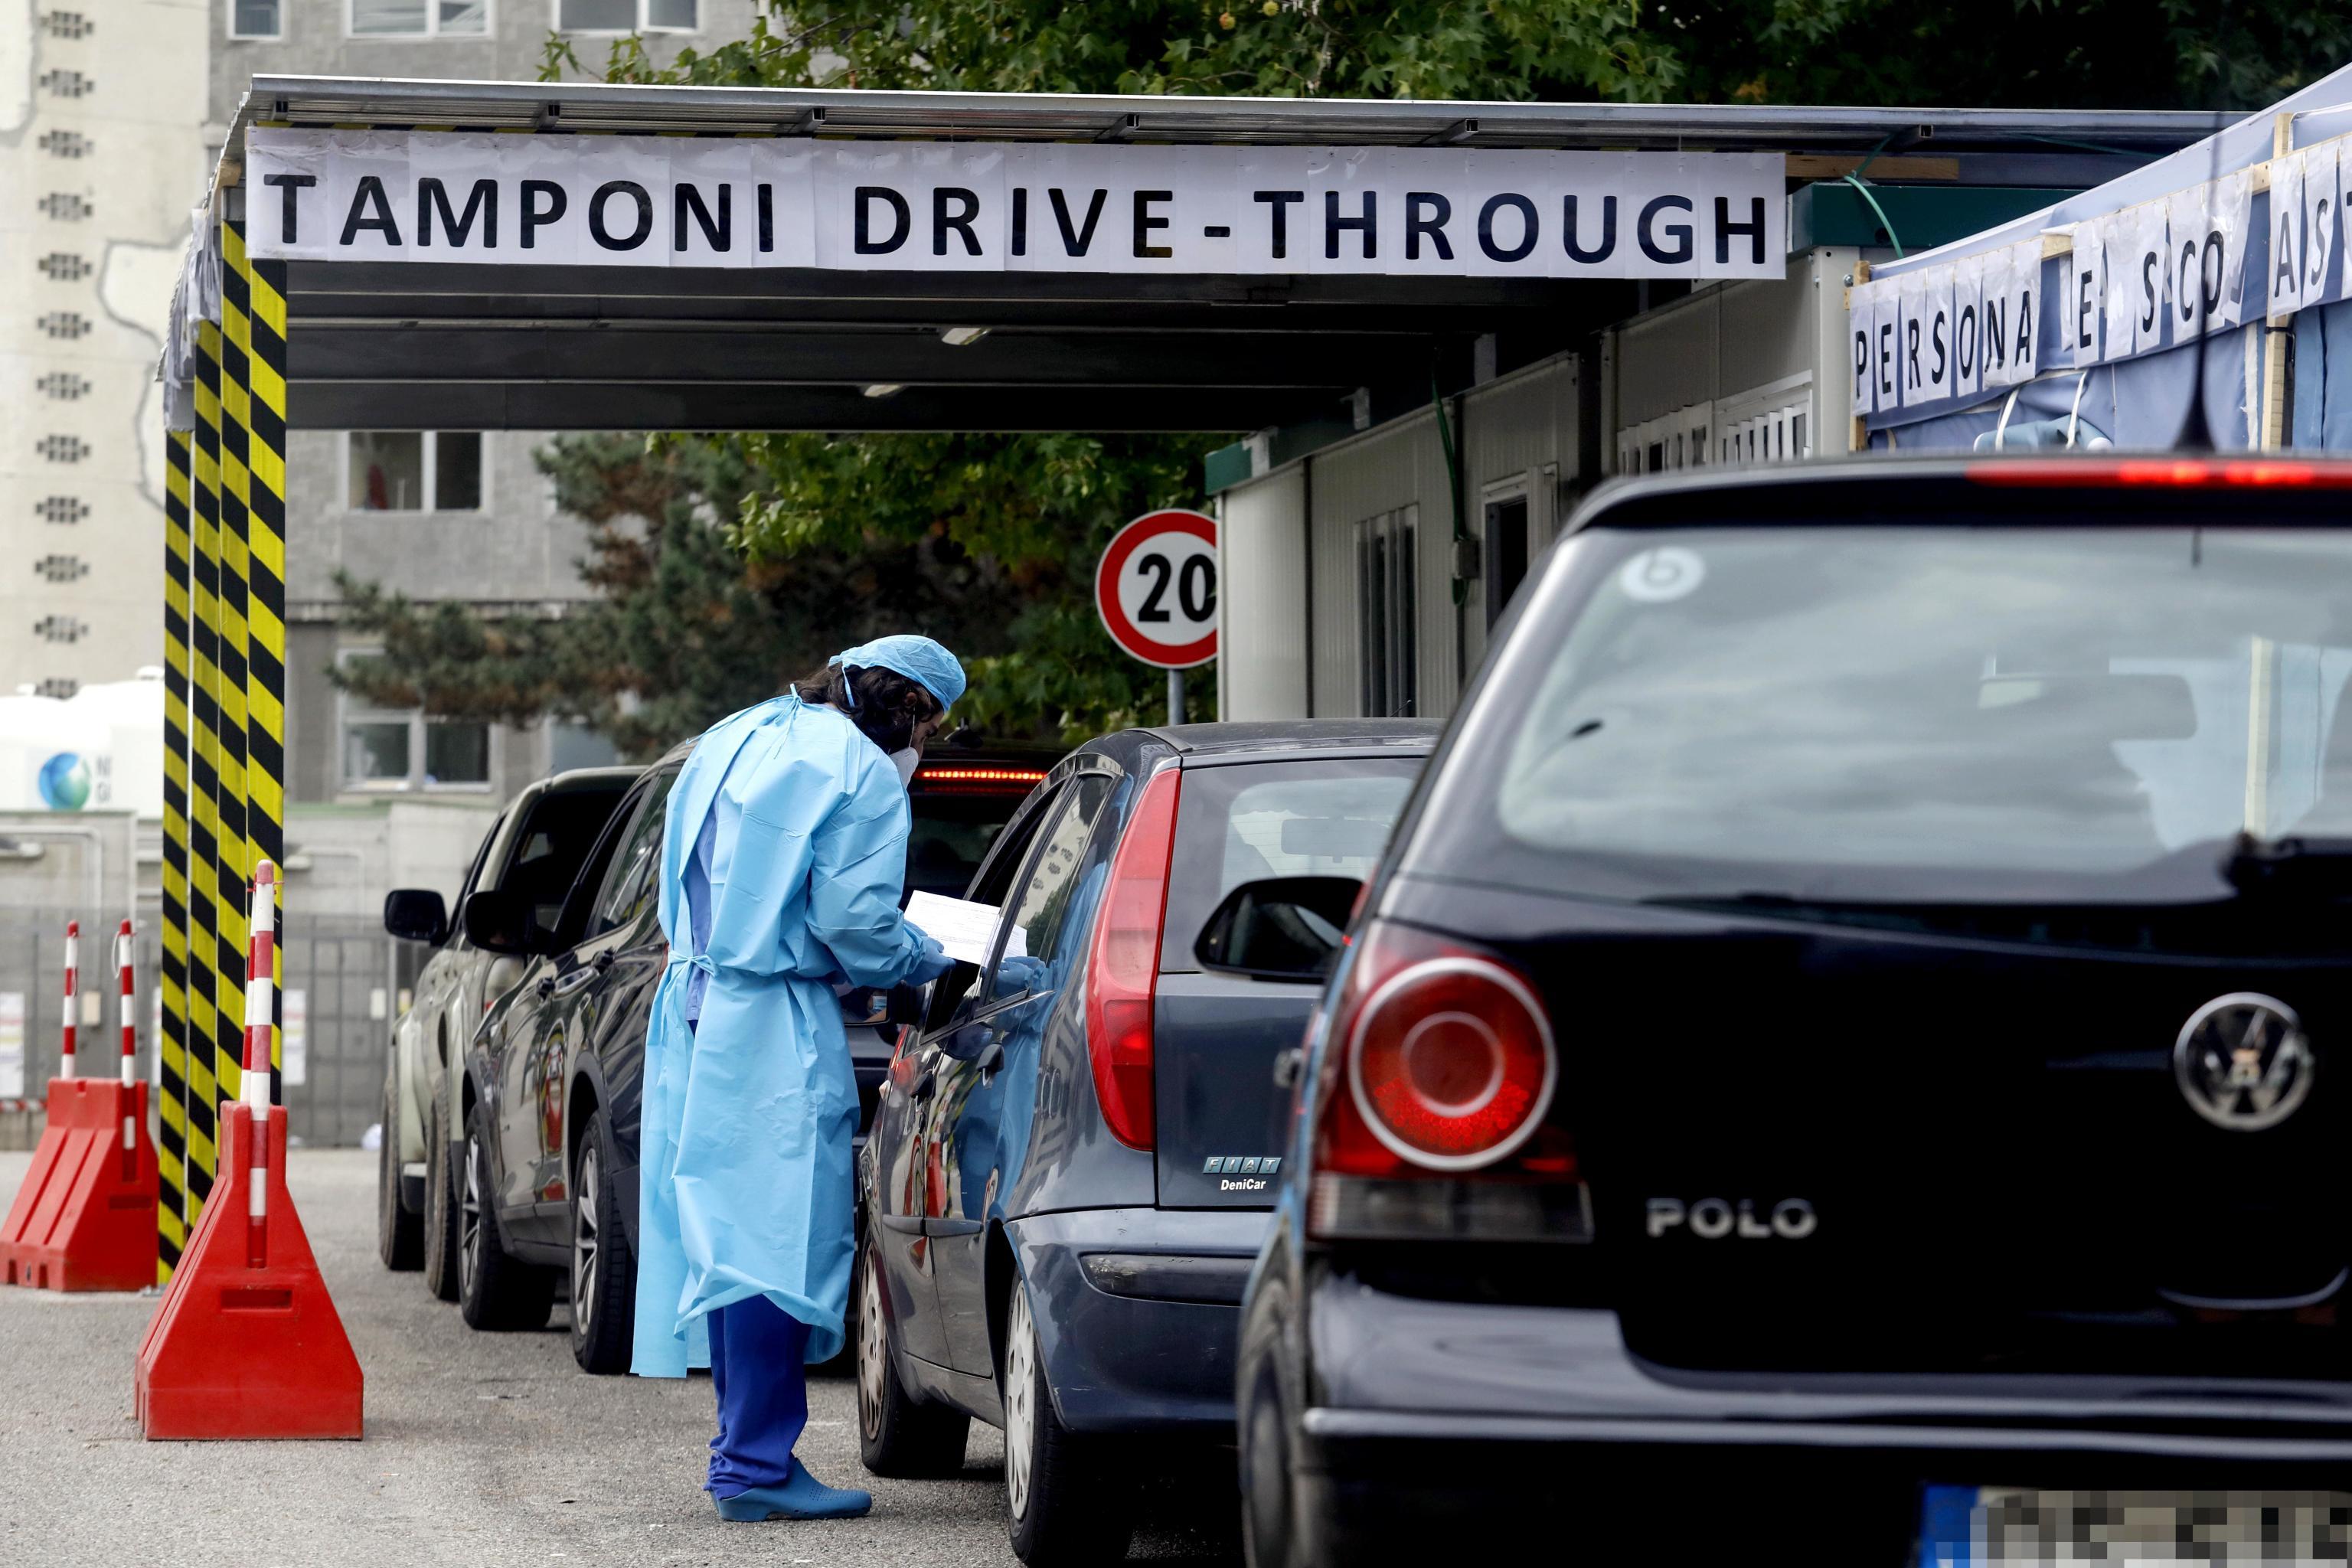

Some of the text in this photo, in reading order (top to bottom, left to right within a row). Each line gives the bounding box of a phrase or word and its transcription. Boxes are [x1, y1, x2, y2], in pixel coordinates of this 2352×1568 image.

[263, 173, 774, 253] TAMPONI
[1138, 554, 1217, 622] 20
[1207, 1158, 1277, 1173] FIAT
[1220, 1178, 1266, 1191] DeniCar
[1646, 1197, 1818, 1239] POLO
